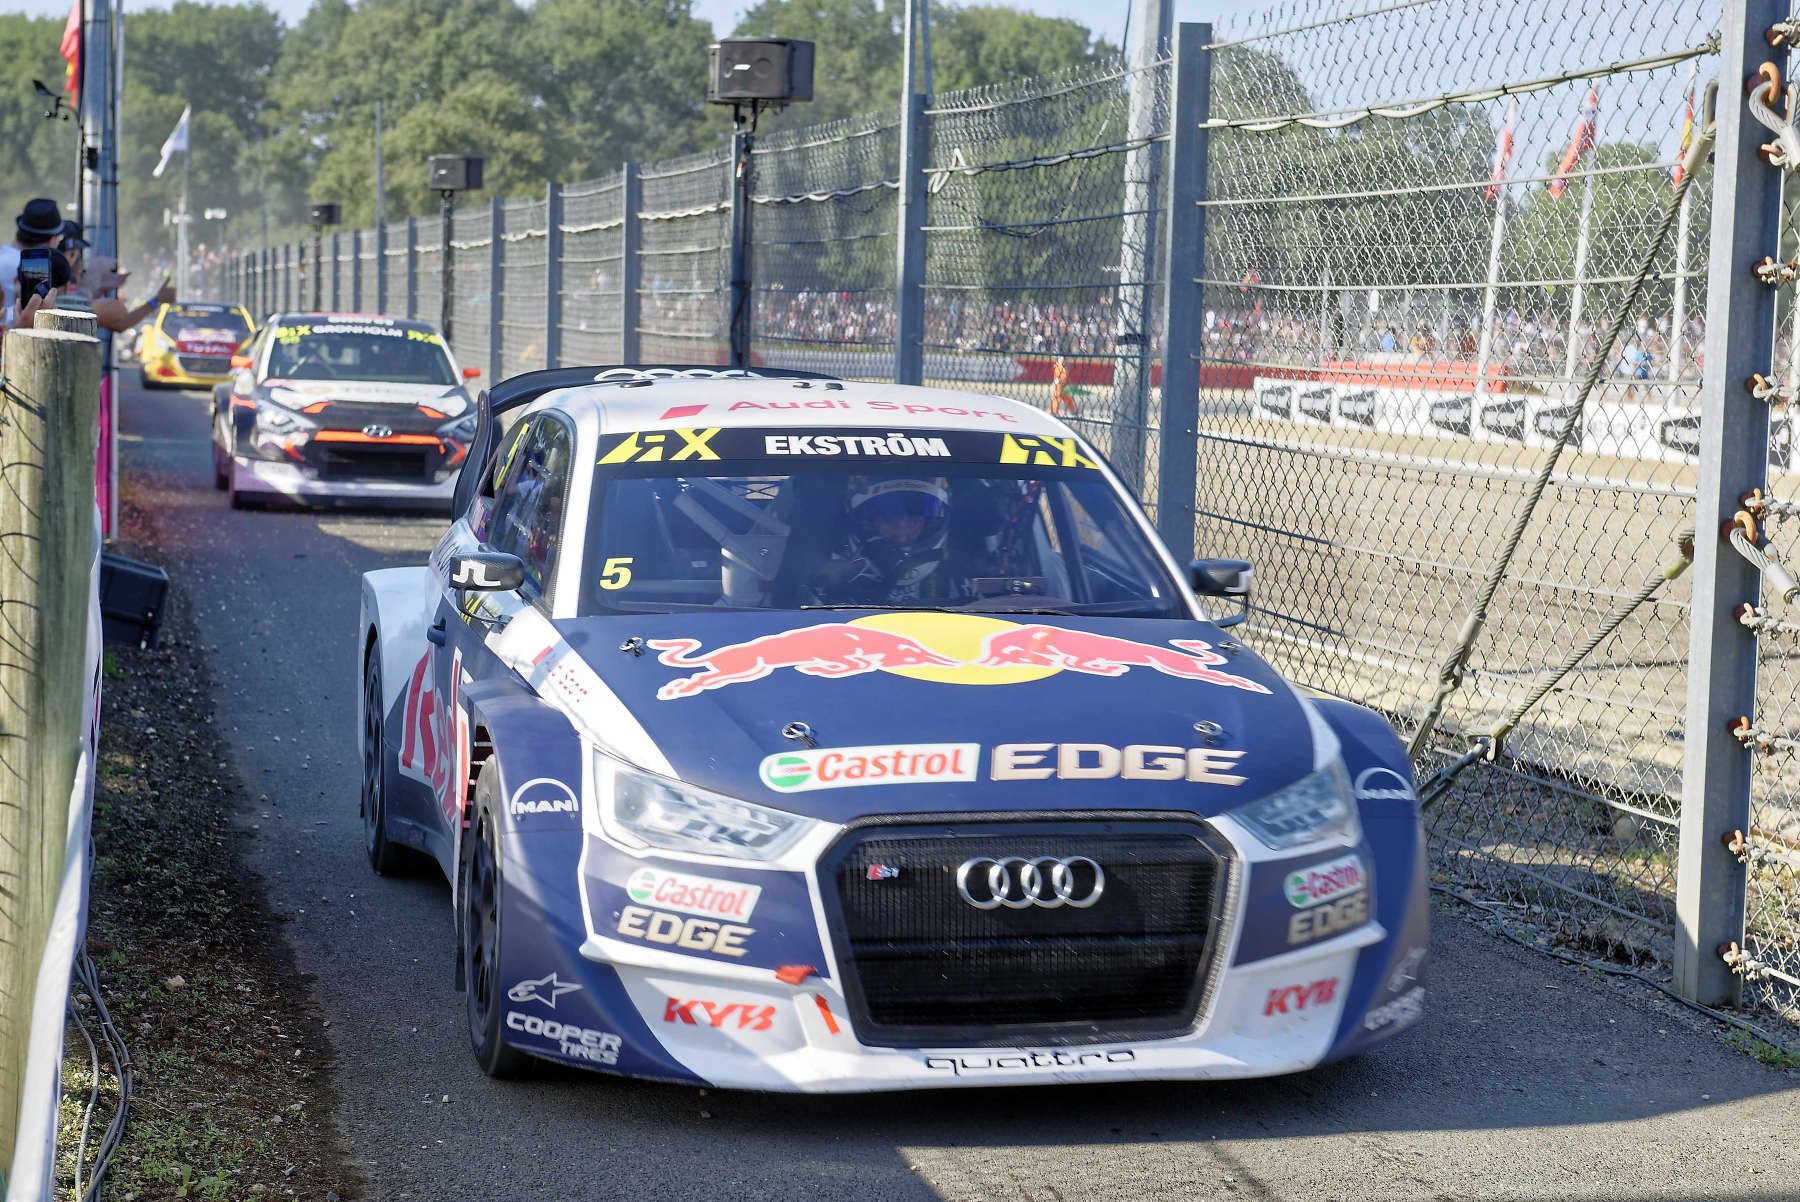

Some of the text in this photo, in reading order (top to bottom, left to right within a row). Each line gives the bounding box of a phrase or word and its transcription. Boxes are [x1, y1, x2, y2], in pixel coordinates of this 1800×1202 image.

[727, 399, 1019, 424] Audi Sport
[765, 432, 952, 458] EKSTRÖM
[600, 557, 633, 590] 5
[816, 743, 1249, 787] Castrol EDGE
[516, 799, 575, 813] MAN
[654, 877, 748, 917] Castrol
[616, 905, 757, 958] EDGE
[664, 996, 776, 1031] KYB
[1263, 977, 1339, 1017] KYB
[506, 1011, 623, 1053] COOPER
[558, 1039, 619, 1066] TIRES
[926, 1050, 1135, 1080] quattro
